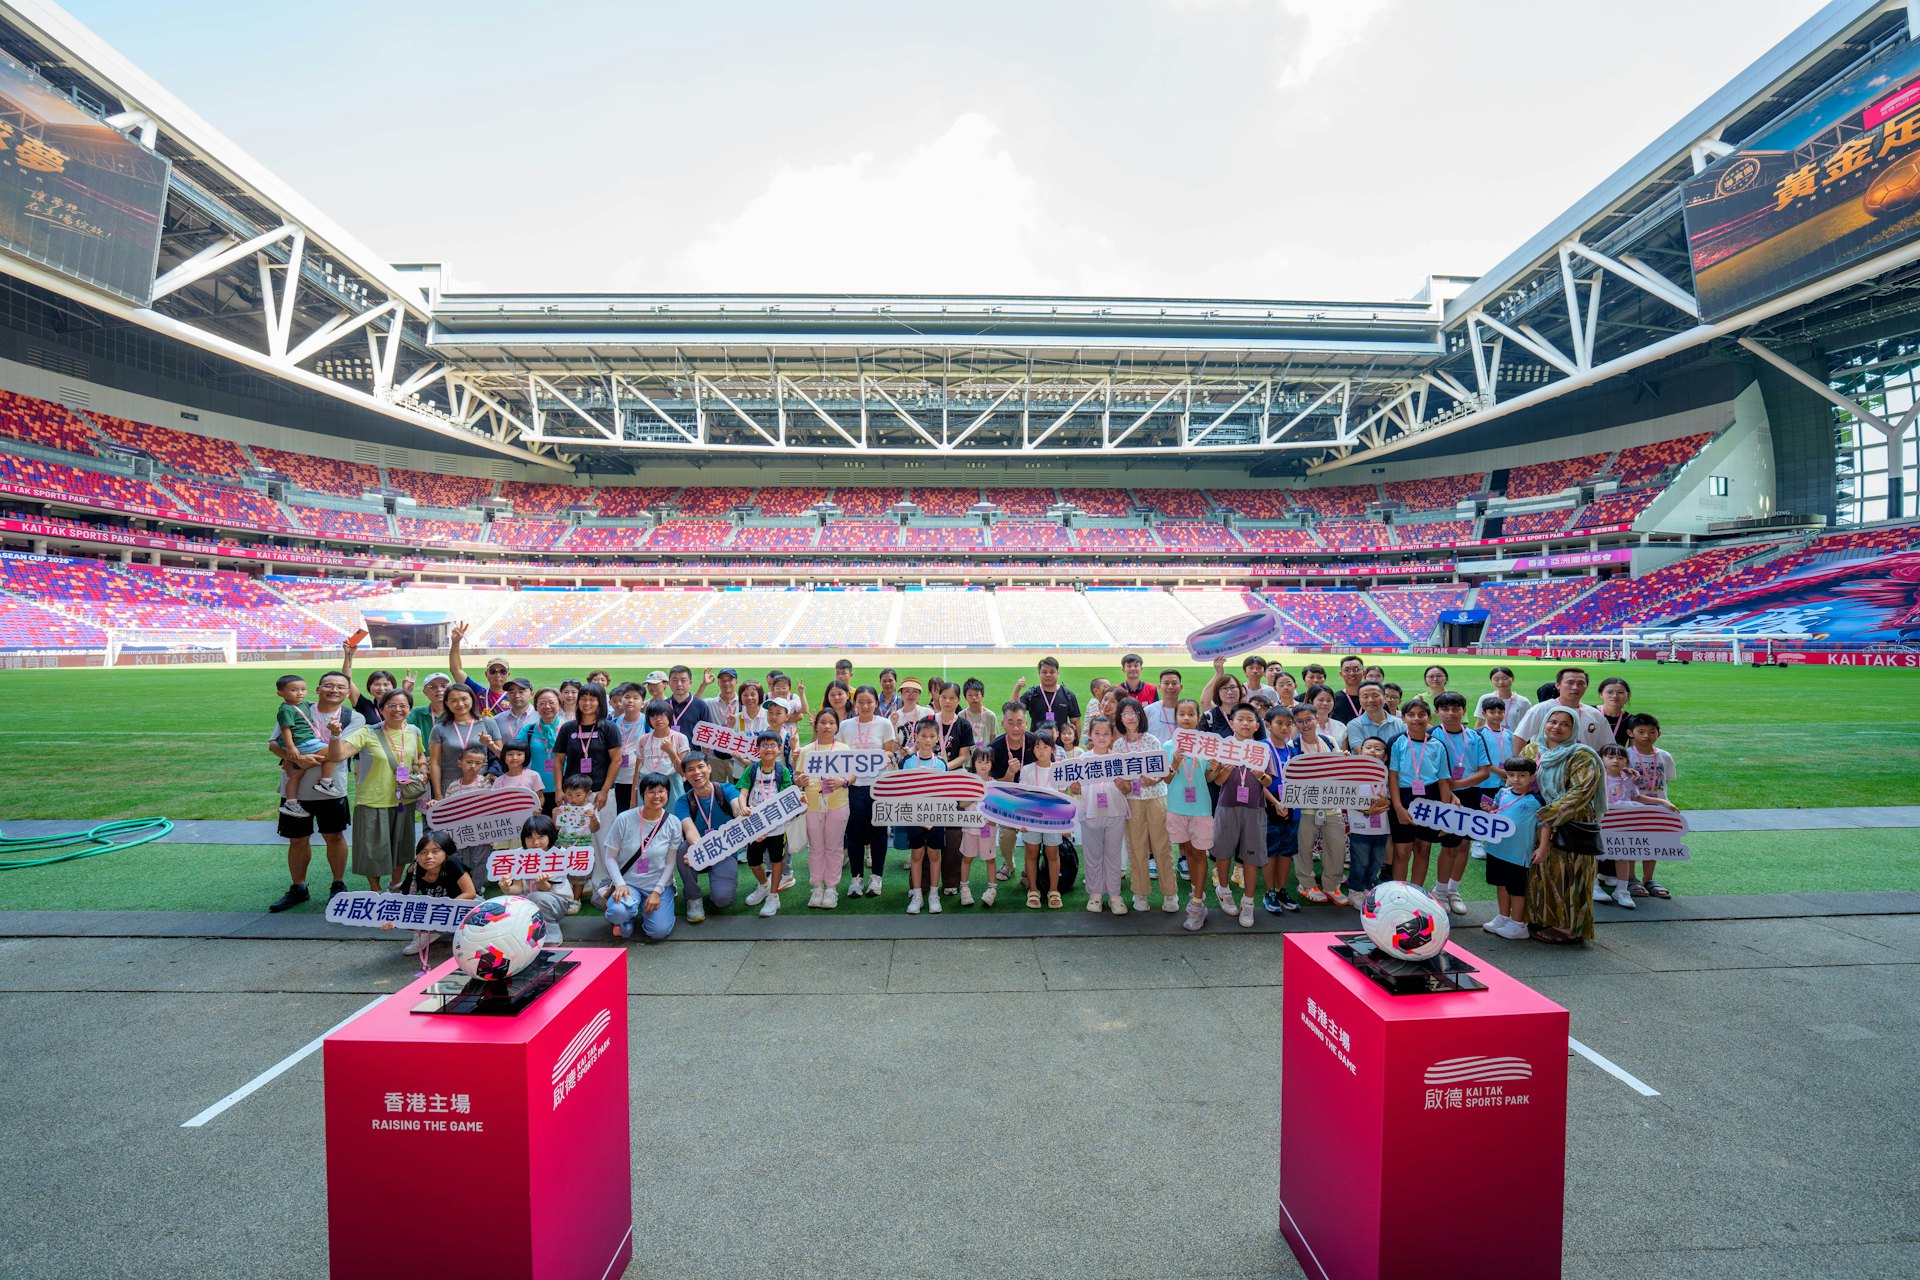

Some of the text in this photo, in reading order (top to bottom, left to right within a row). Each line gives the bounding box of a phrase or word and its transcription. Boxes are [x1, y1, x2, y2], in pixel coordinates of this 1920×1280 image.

[14, 486, 31, 495] TAK
[34, 490, 67, 500] SPORTS
[69, 495, 90, 504] PARK
[216, 518, 240, 527] SPORTS
[22, 523, 136, 544] KAI TAK SPORTS PARK
[290, 554, 320, 563] SPORTS
[162, 568, 215, 576] #FIFAASEANCUP
[136, 655, 159, 665] KAI
[164, 654, 188, 664] TAK
[241, 653, 267, 661] PARK
[1575, 650, 1609, 659] SPORTS
[1828, 654, 1856, 665] KAI
[1862, 654, 1897, 666] TAK
[1176, 732, 1265, 766] 香港主場
[808, 754, 884, 773] #KTSP
[1054, 755, 1164, 782] #啟德體育園
[1283, 785, 1319, 805] 啟德
[1323, 786, 1356, 795] KAI TAK
[917, 803, 955, 812] KAI TAK
[1322, 796, 1378, 806] SPORTS PAR
[874, 802, 912, 822] 啟德
[916, 813, 982, 824] SPORTS PARK
[476, 818, 512, 831] KAI TAK
[1413, 803, 1510, 839] #KTSP
[479, 828, 514, 841] SPORTS
[693, 791, 801, 865] #啟德體育園
[1607, 837, 1650, 846] KAI TAK
[1607, 846, 1684, 857] SPORTS PARK
[492, 851, 589, 876] 香港主場
[1307, 997, 1350, 1052] 香港主場
[1301, 1012, 1356, 1076] RAISING THE GAME
[577, 1042, 597, 1072] KAI TAK
[577, 1037, 610, 1082] SPORTS PARK
[553, 1068, 576, 1111] 啟德
[1466, 1086, 1503, 1097] KAI TAK
[384, 1092, 470, 1114] 香港主場
[1424, 1088, 1462, 1110] 啟德
[1466, 1095, 1529, 1108] SPORTS PARK
[372, 1119, 484, 1132] RAISING THE GAME
